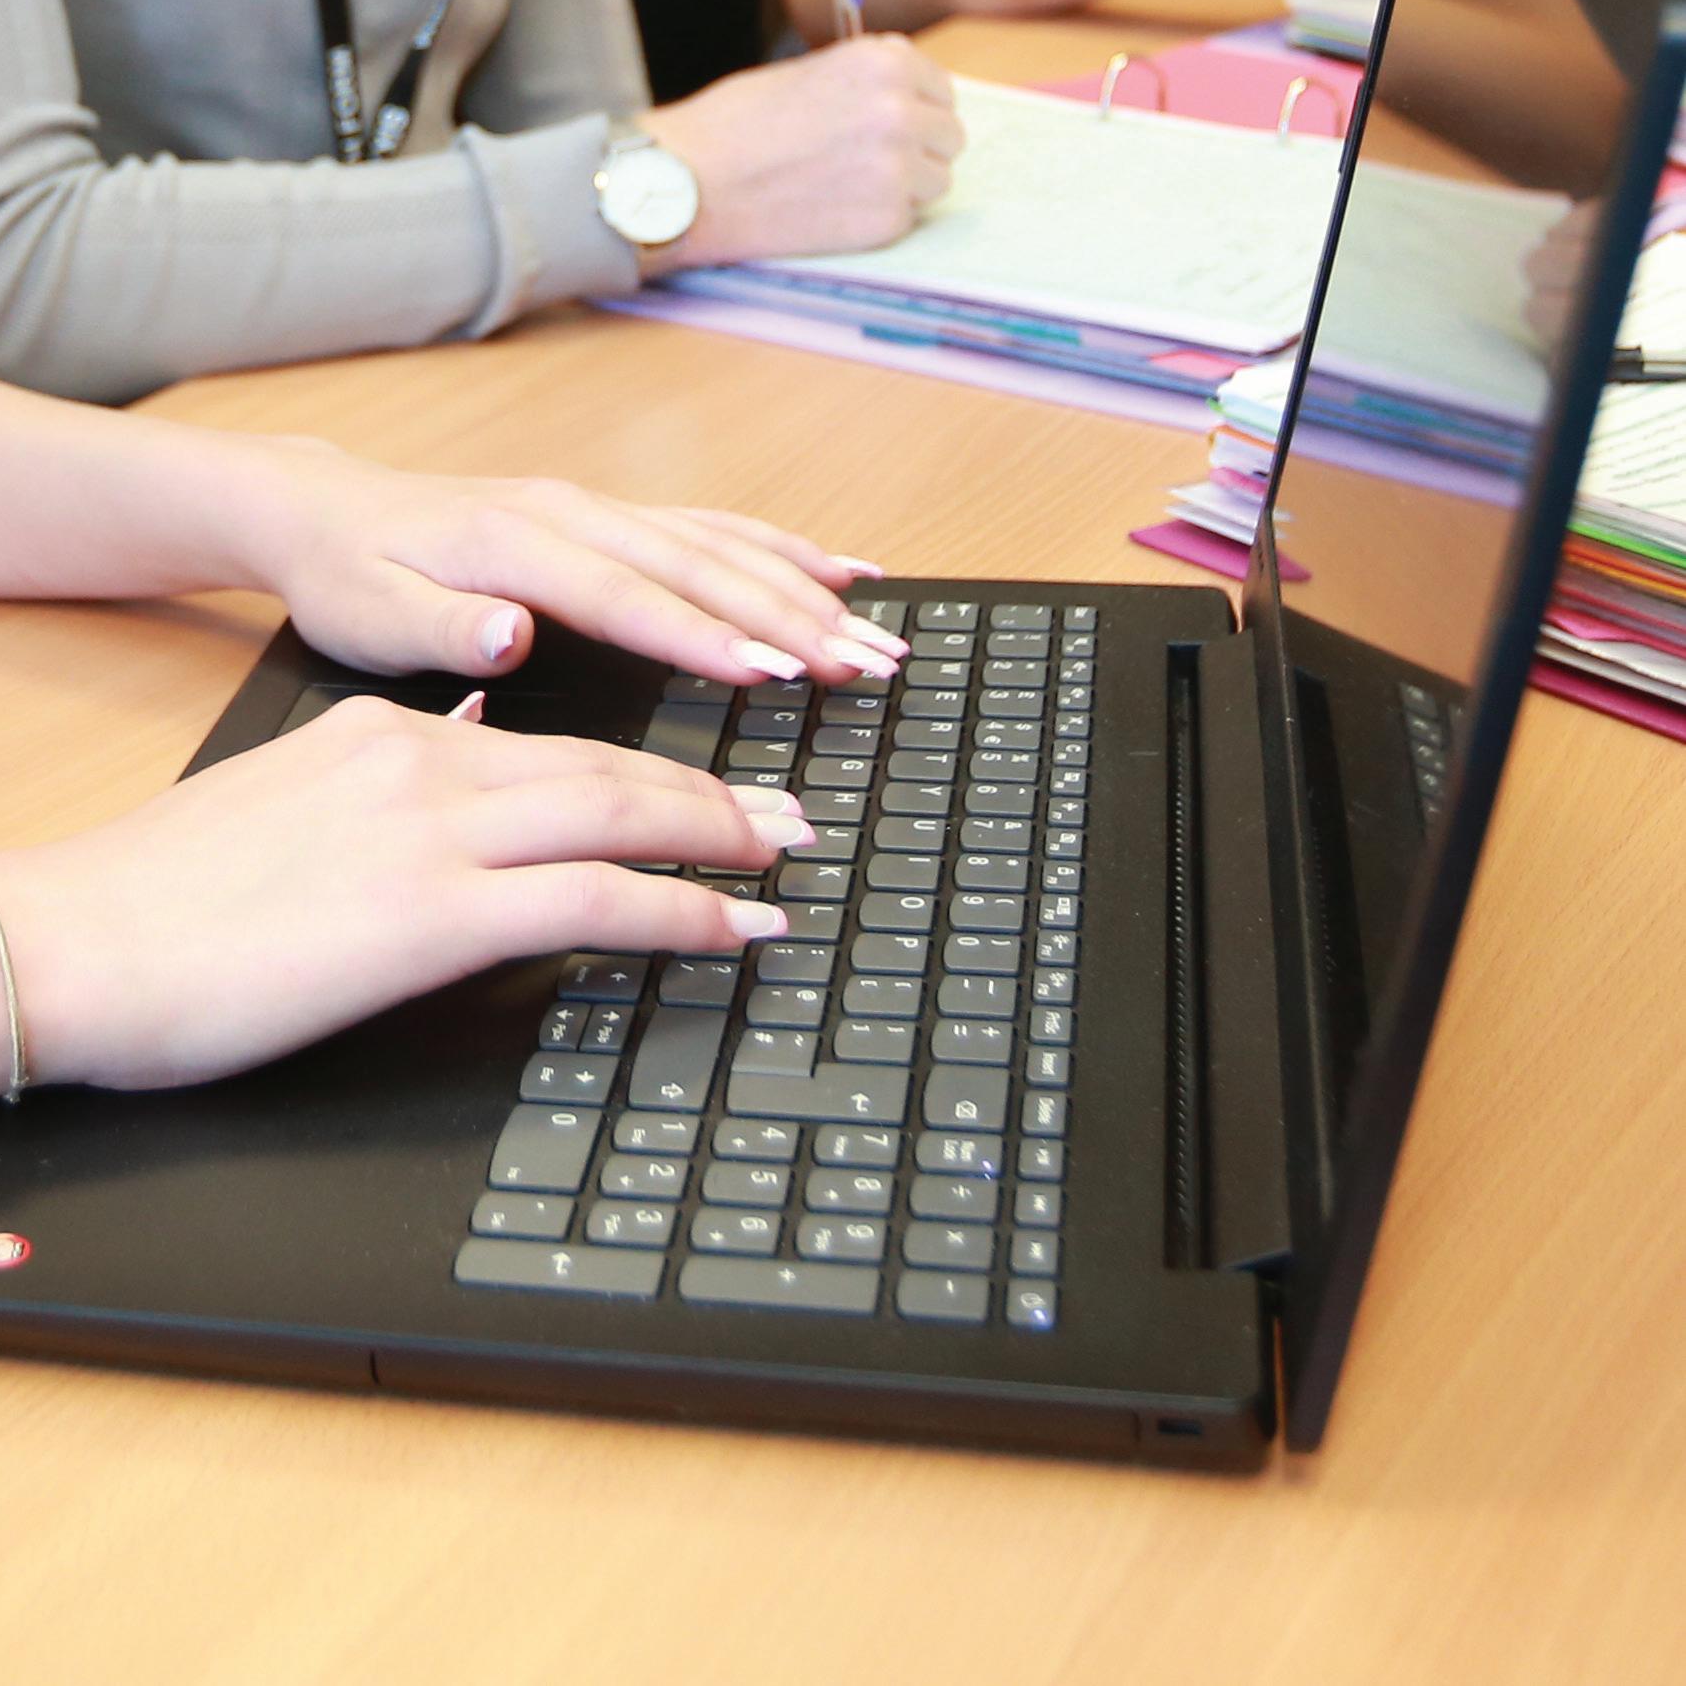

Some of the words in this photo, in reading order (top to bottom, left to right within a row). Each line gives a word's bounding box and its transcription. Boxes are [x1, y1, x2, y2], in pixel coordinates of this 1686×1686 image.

[944, 634, 966, 644] Q
[940, 662, 962, 675] W
[935, 692, 958, 701] E
[856, 698, 878, 708] D
[774, 712, 796, 722] C
[930, 722, 952, 732] R
[849, 728, 871, 738] F
[765, 742, 788, 752] V
[925, 754, 948, 763] T
[841, 760, 864, 770] G
[756, 774, 779, 783] B
[920, 787, 942, 795] Y
[834, 793, 857, 803] H
[913, 820, 937, 830] U
[827, 828, 849, 837] J
[818, 867, 842, 877] K
[900, 897, 925, 909] O
[810, 906, 834, 914] L
[895, 937, 918, 948] P
